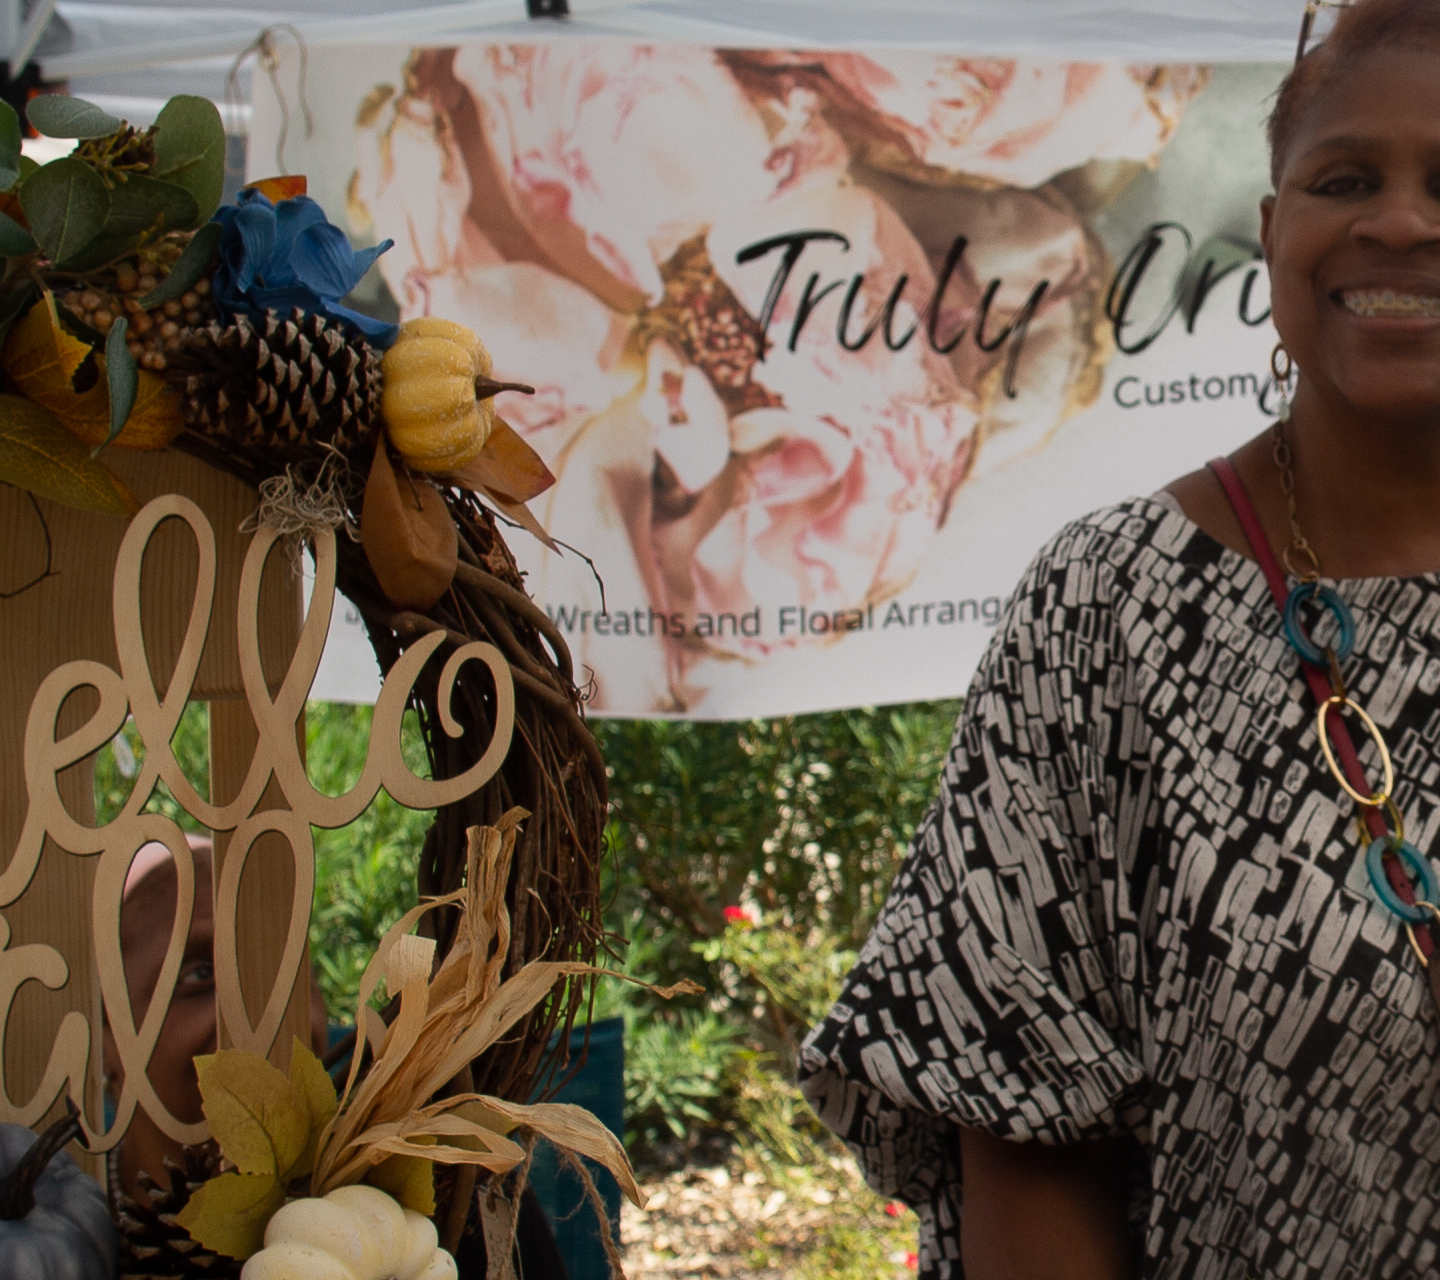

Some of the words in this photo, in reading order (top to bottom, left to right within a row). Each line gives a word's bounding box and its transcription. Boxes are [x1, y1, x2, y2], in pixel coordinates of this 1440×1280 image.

[737, 233, 1049, 399] Truly
[1113, 370, 1260, 409] Custom
[546, 604, 685, 638] Wreaths
[695, 604, 761, 637] and
[778, 604, 873, 637] Floral
